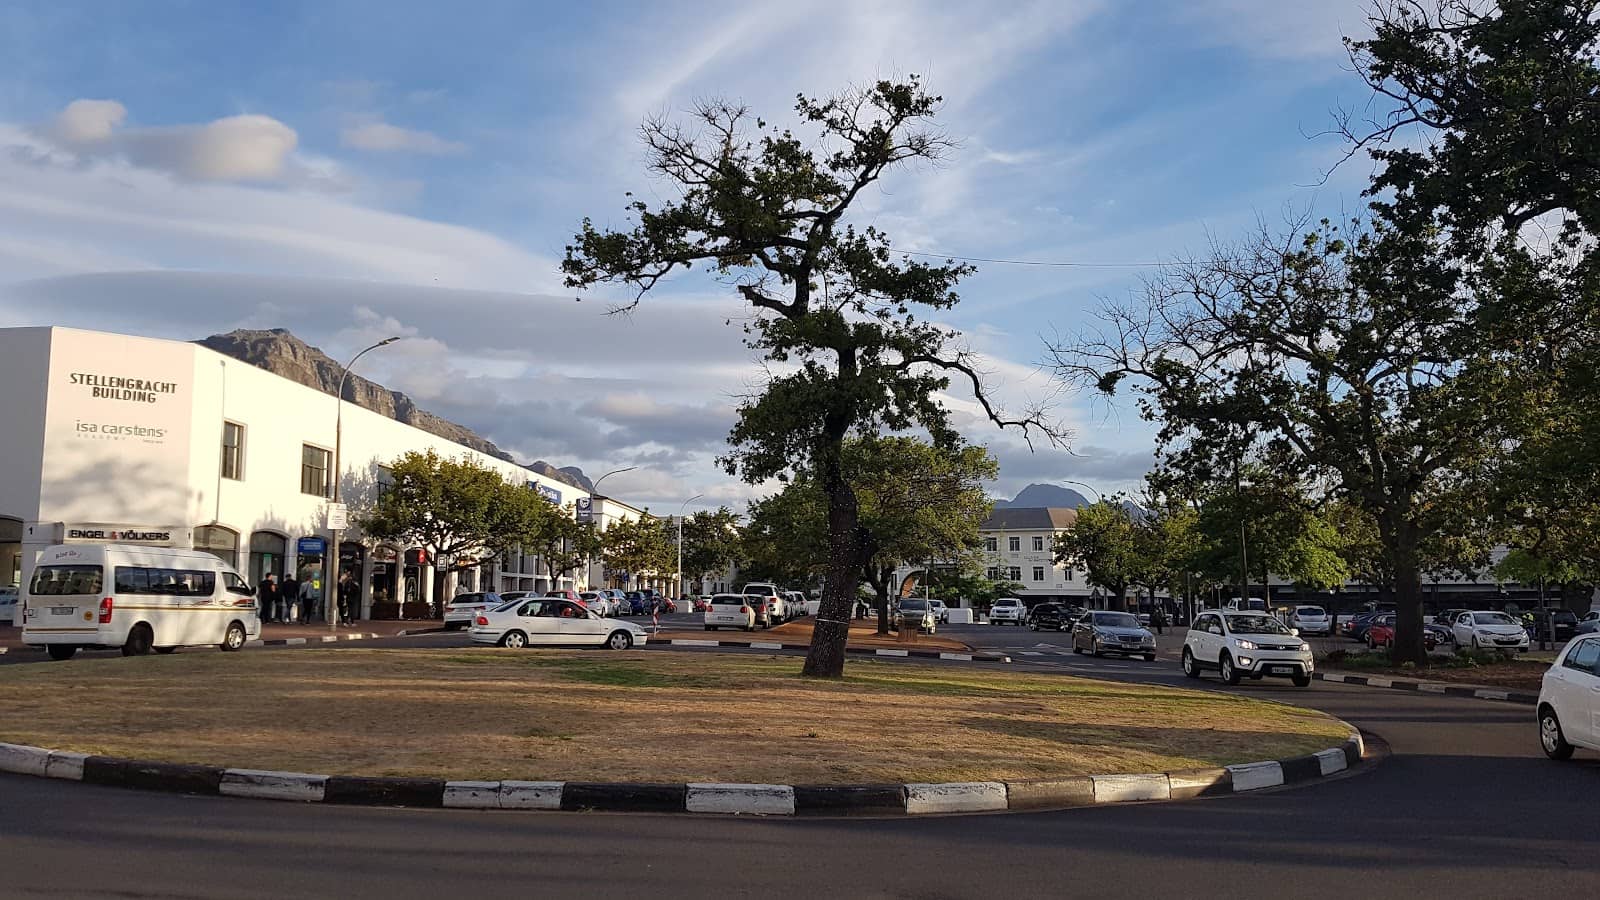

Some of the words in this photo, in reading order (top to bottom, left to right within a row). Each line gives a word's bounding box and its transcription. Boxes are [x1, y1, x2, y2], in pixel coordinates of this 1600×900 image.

[69, 373, 177, 393] STELLENGRACHT
[92, 386, 156, 403] BUILDING
[76, 419, 98, 433] isa
[101, 424, 164, 438] carstens
[70, 529, 105, 539] ENGEL
[111, 531, 118, 540] &
[120, 529, 170, 541] VÖLKERS
